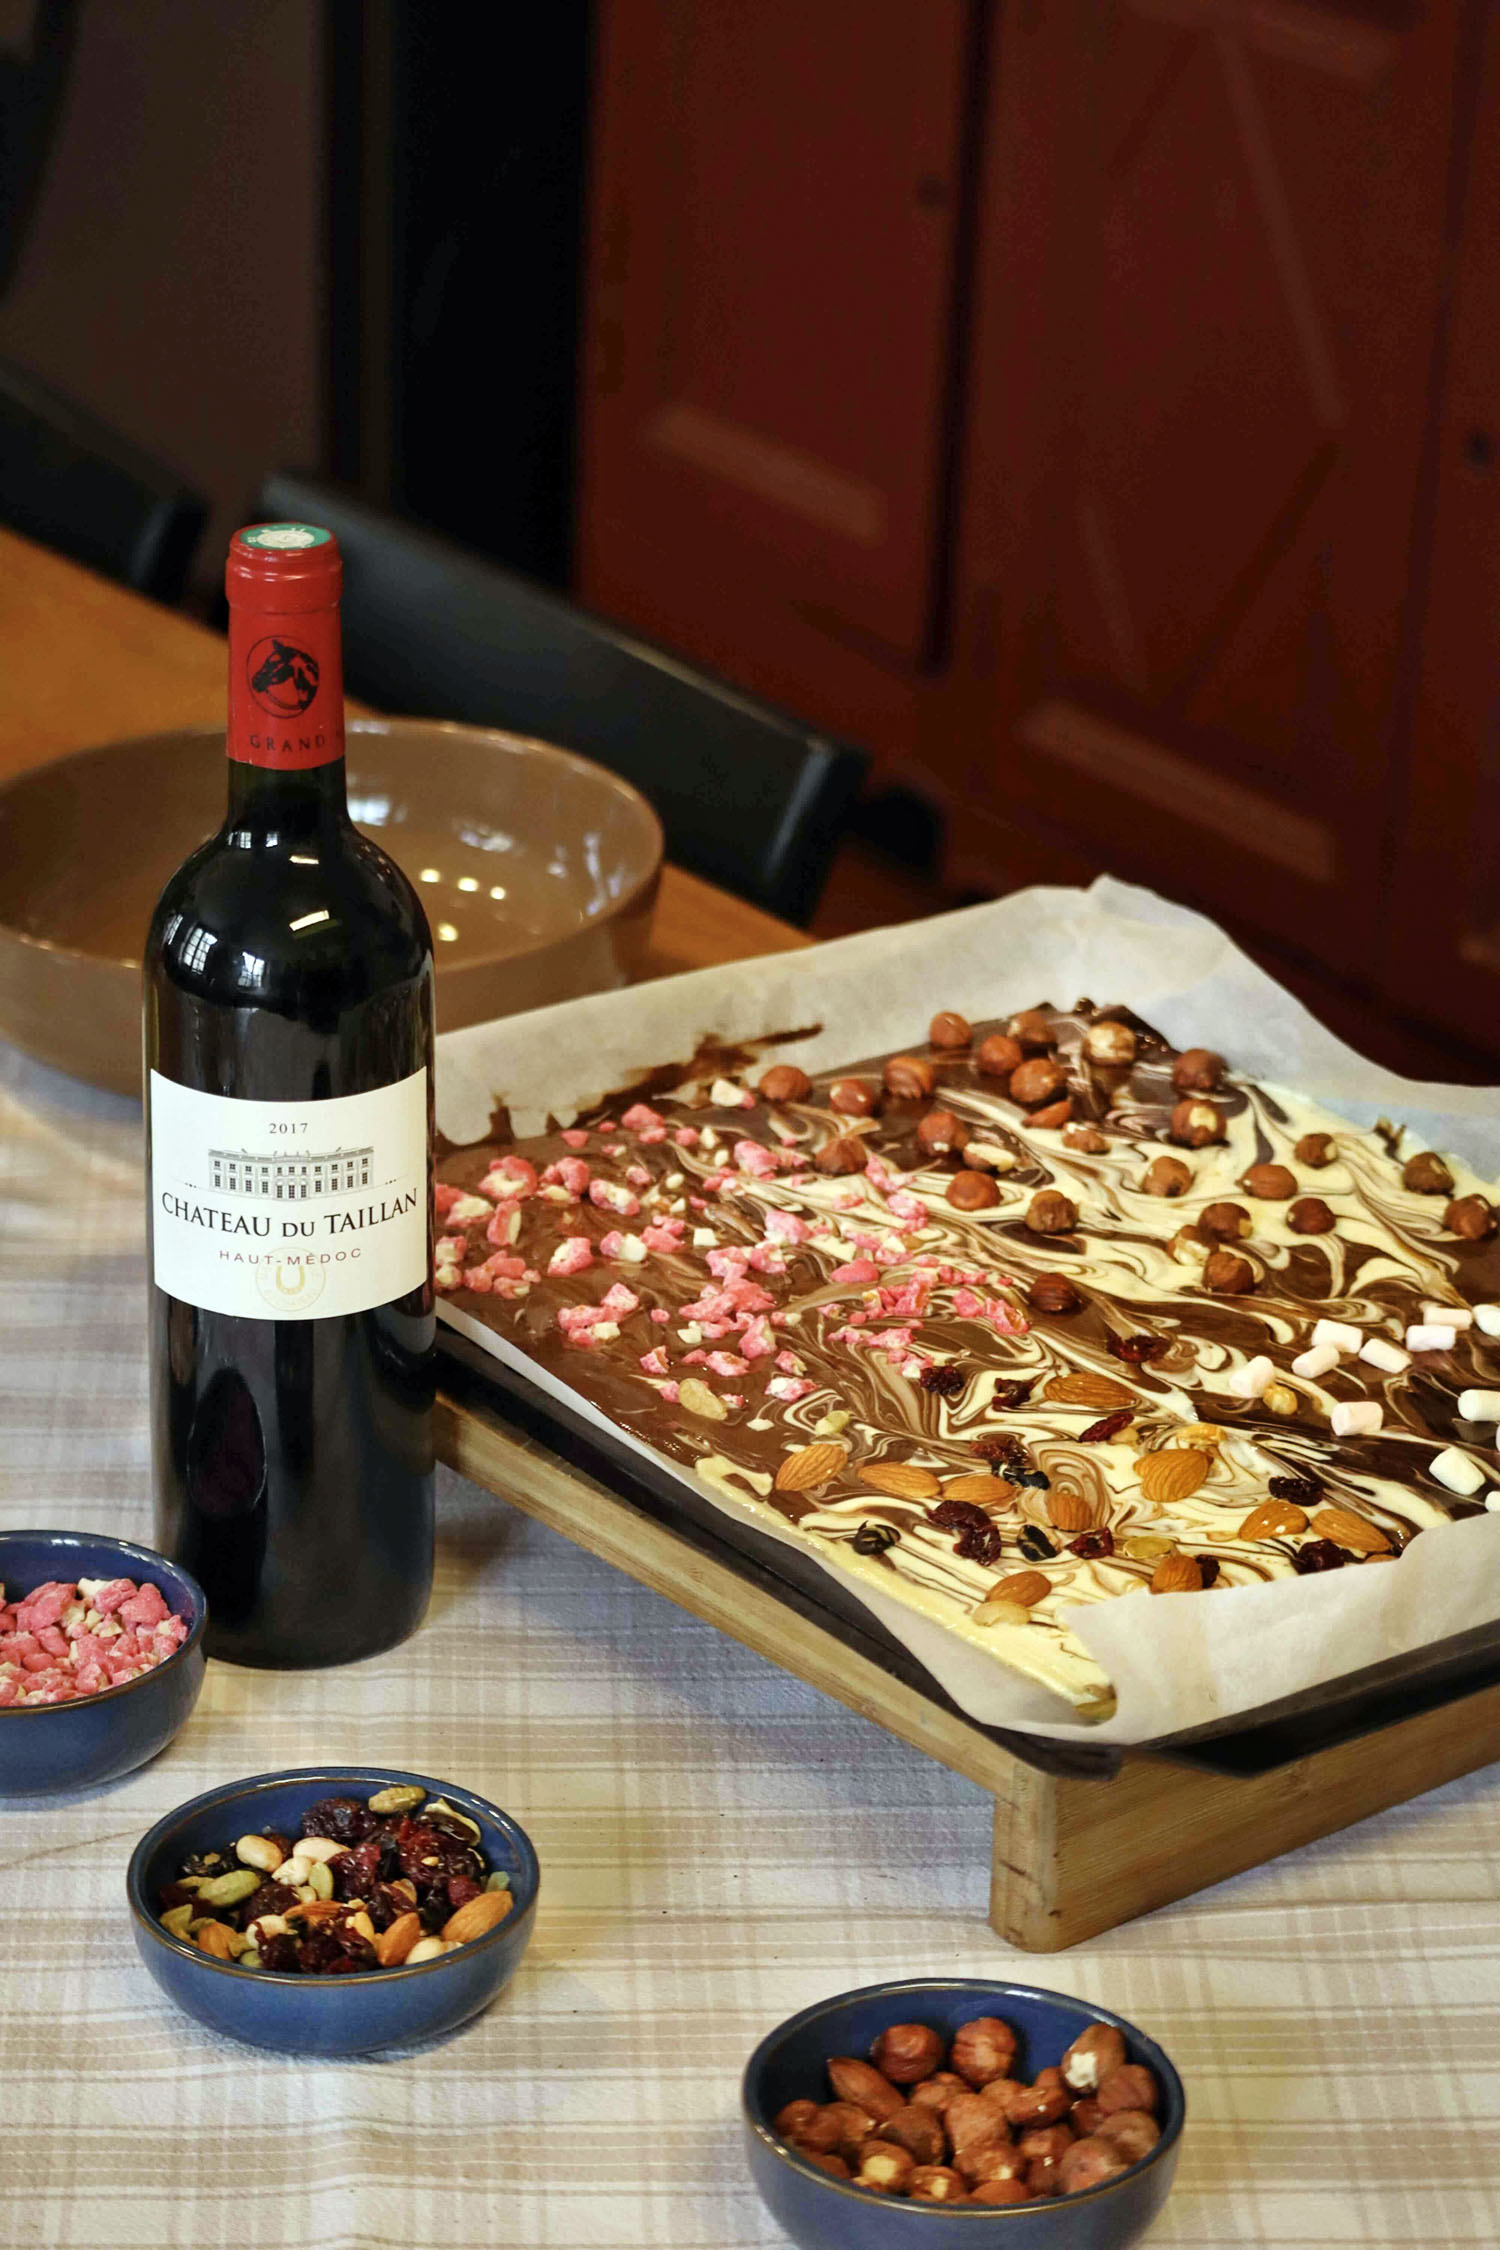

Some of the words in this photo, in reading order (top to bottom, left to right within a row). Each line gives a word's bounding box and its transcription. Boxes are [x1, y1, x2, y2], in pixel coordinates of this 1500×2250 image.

[249, 734, 326, 753] GRAND
[269, 1123, 309, 1134] 2017
[161, 1191, 271, 1237] CHATEAU
[282, 1221, 316, 1238] DU
[323, 1187, 418, 1235] TAILLAN
[219, 1247, 363, 1266] HAUT-MÉDOC
